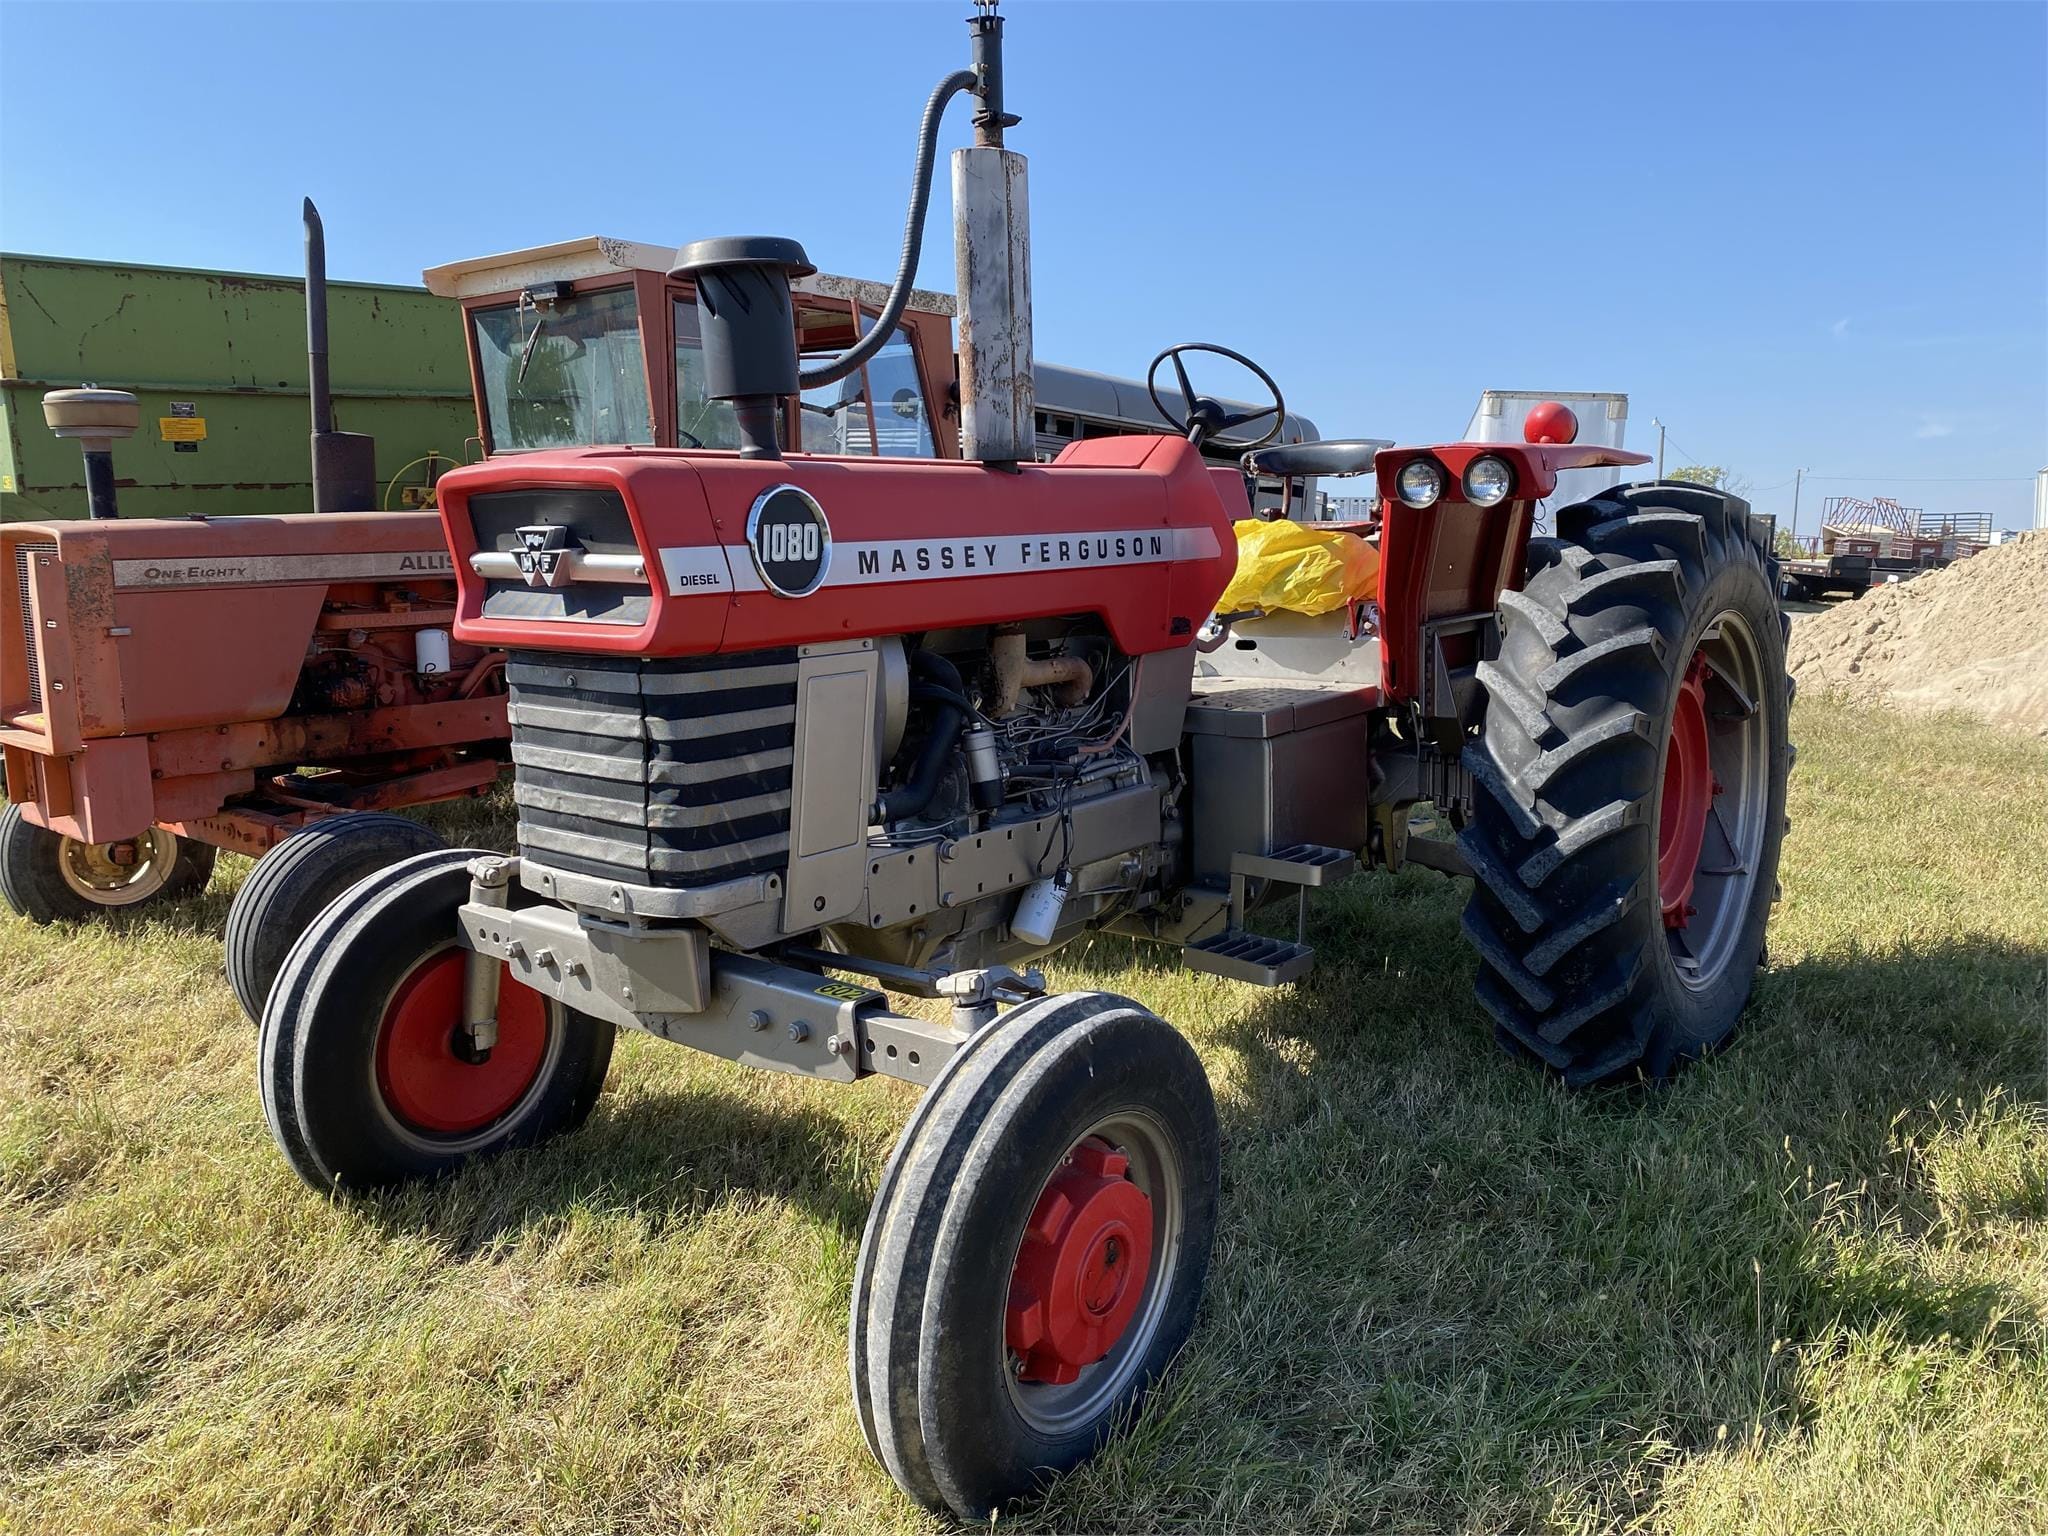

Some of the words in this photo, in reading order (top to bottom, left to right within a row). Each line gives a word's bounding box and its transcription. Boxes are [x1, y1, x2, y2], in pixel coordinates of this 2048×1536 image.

[762, 523, 818, 563] 1080
[857, 543, 997, 575] MASSEY
[1020, 535, 1162, 564] FERGUSON
[680, 573, 720, 587] DIESEL
[819, 983, 867, 1000] 602
